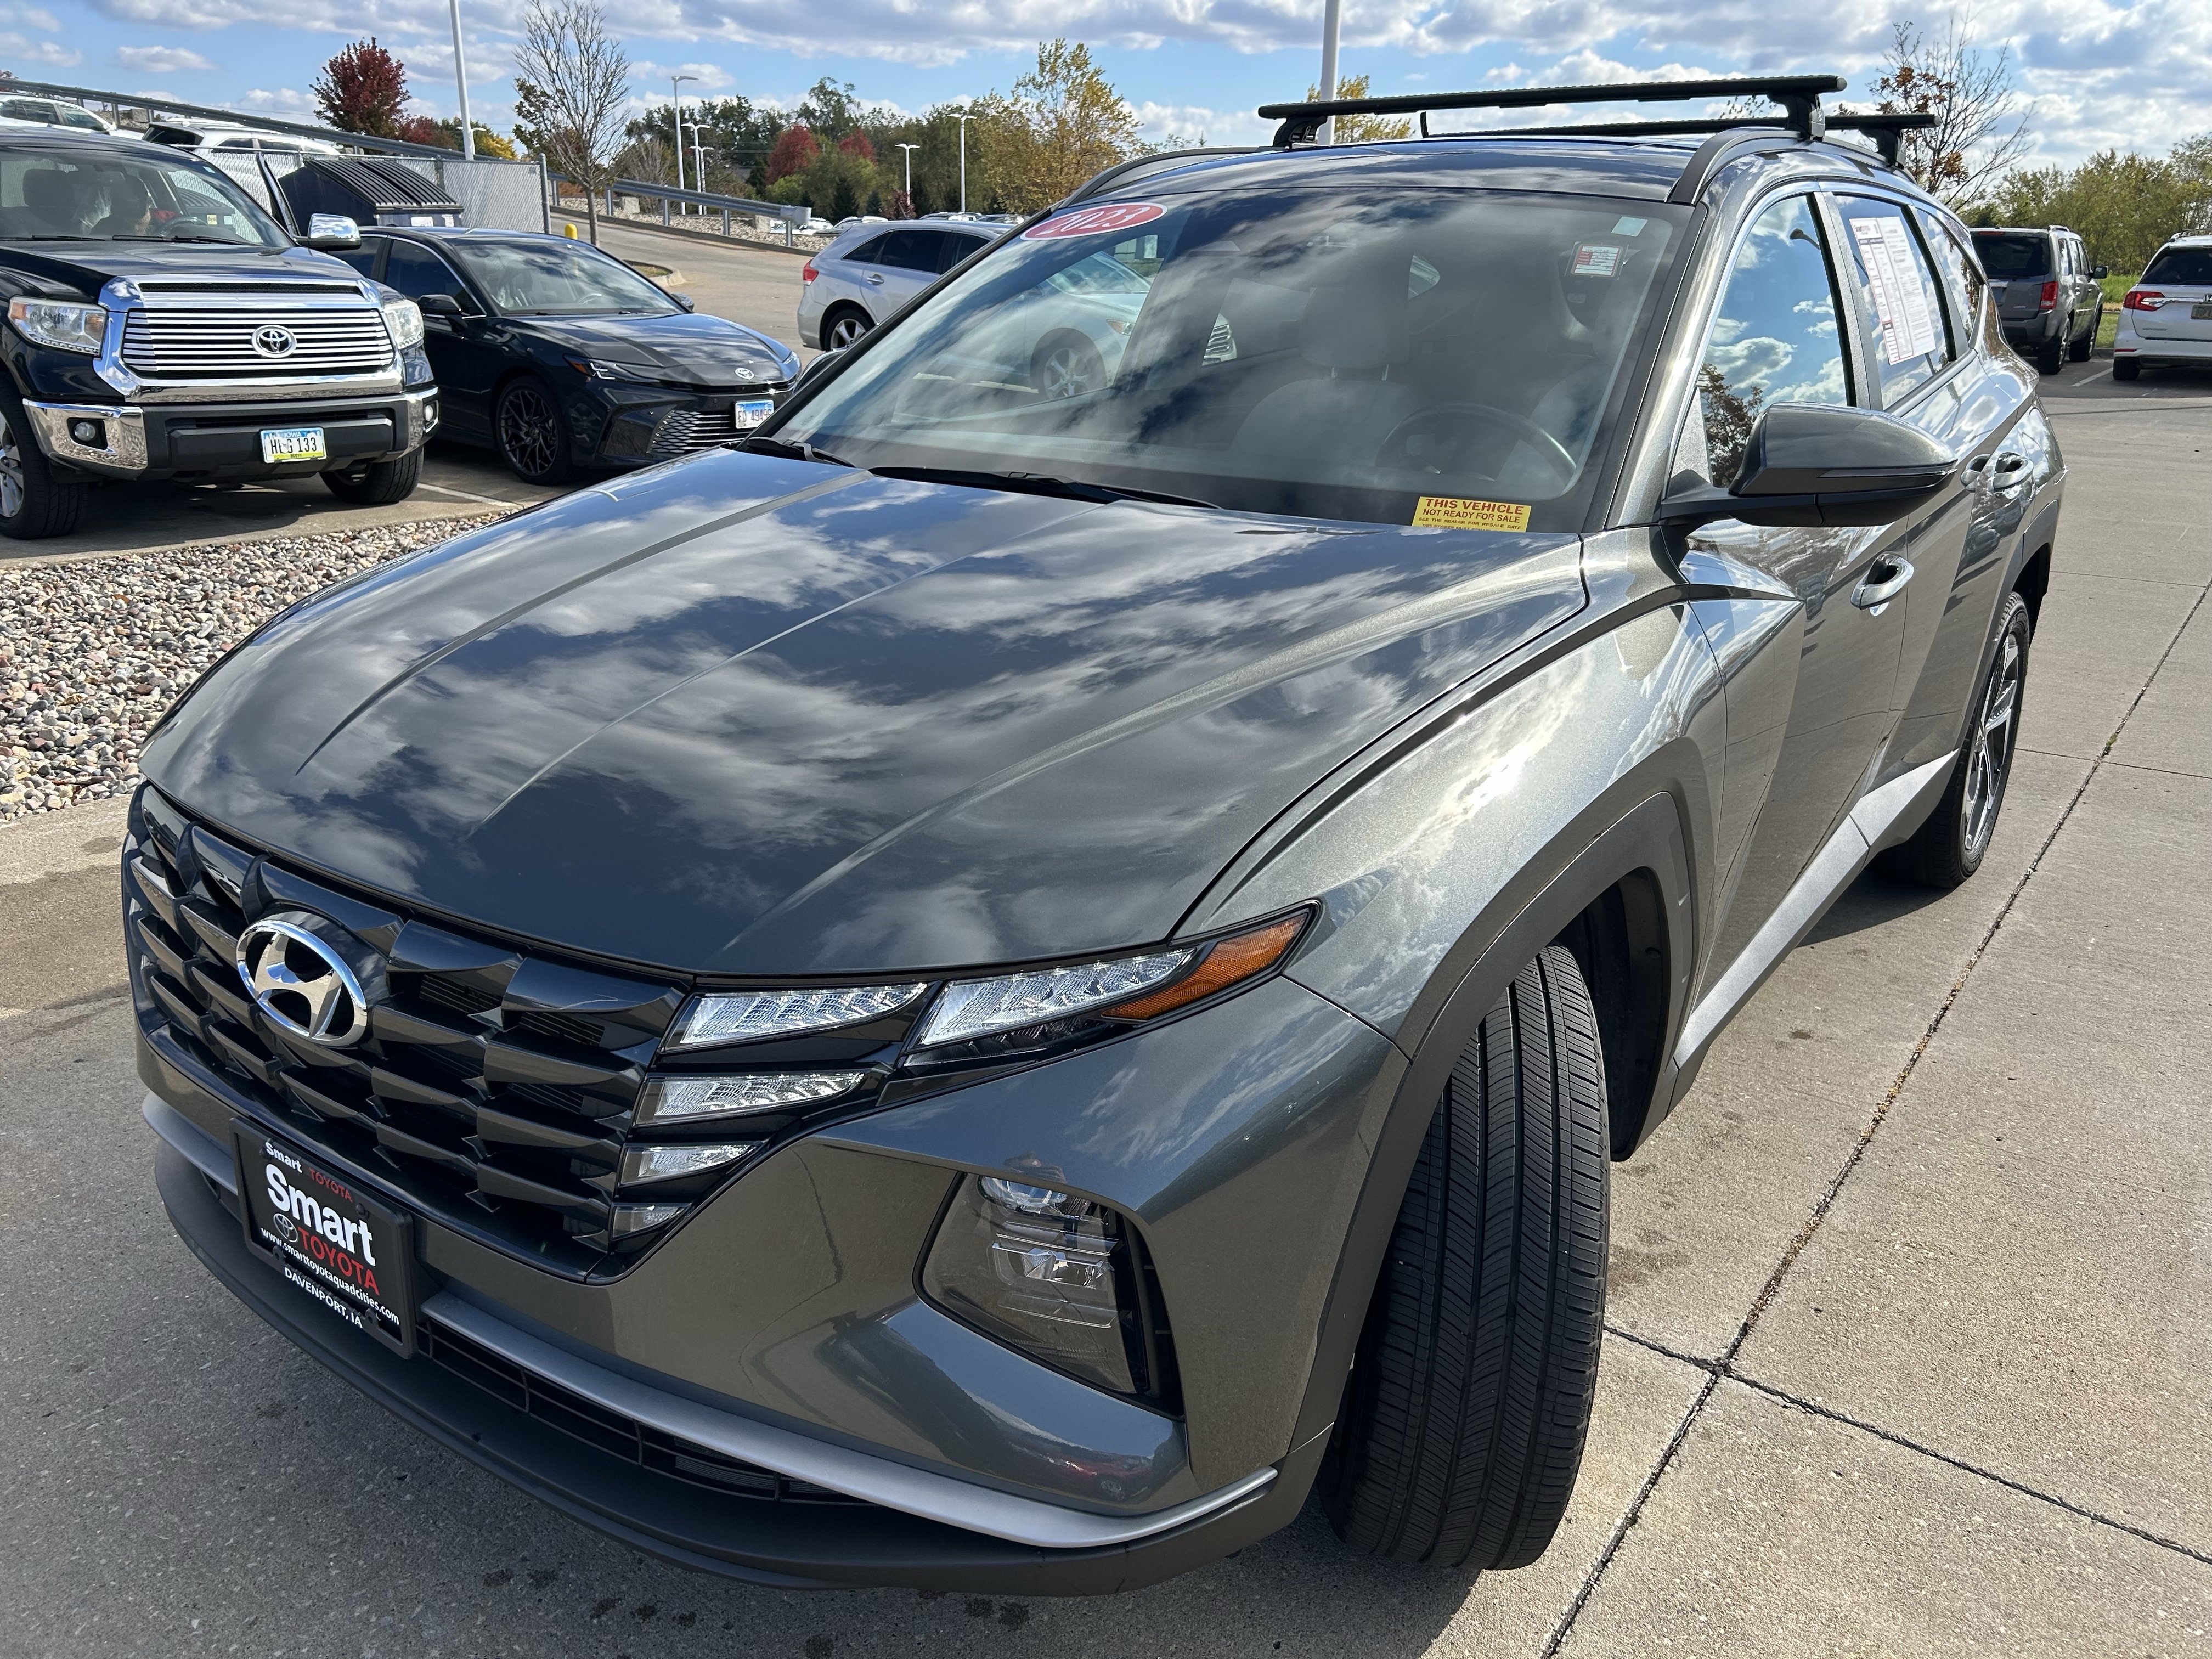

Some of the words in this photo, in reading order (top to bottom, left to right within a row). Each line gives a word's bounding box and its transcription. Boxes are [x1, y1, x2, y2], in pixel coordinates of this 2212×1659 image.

[1035, 206, 1151, 236] 2023
[297, 437, 317, 453] 133
[1426, 498, 1458, 509] THIS
[1463, 501, 1524, 515] VEHICLE
[1443, 510, 1474, 518] READY
[1476, 512, 1494, 521] FOR
[1497, 515, 1520, 523] SALE
[266, 1142, 302, 1173] Smart
[308, 1167, 353, 1203] TOYOTA
[266, 1164, 376, 1267] Smart
[261, 1227, 399, 1325] www.smarttoyotaquadcities.com
[298, 1227, 380, 1295] TOYOTA
[284, 1267, 348, 1319] DAVENPORT,
[351, 1312, 363, 1328] IA
